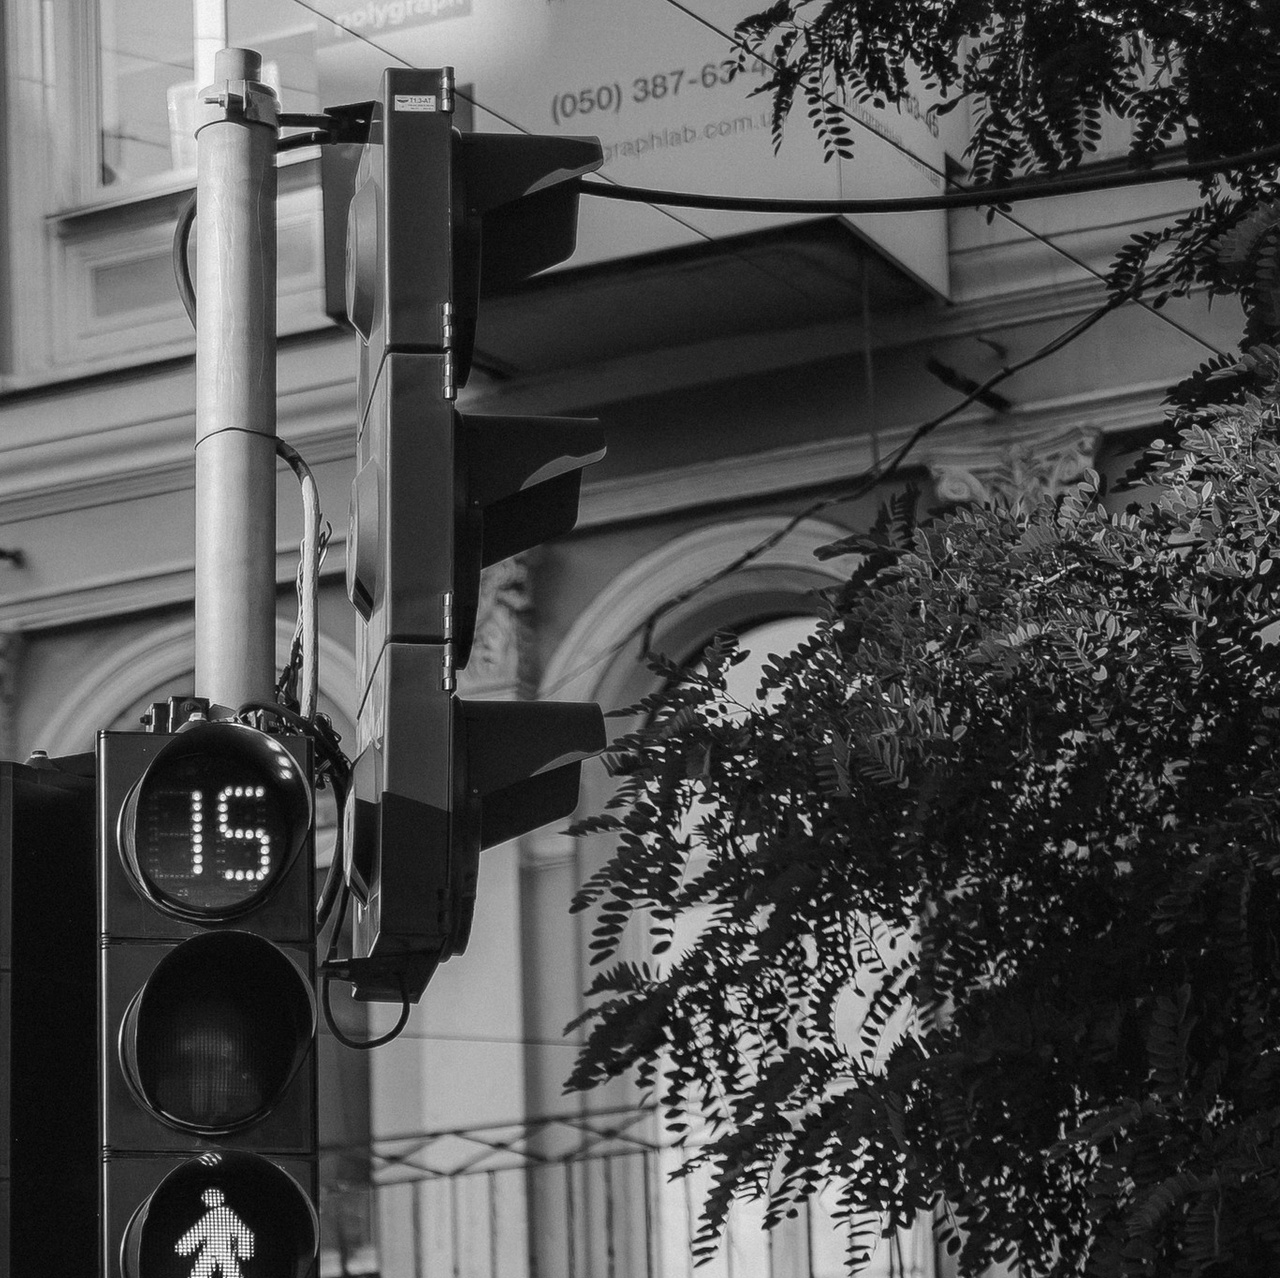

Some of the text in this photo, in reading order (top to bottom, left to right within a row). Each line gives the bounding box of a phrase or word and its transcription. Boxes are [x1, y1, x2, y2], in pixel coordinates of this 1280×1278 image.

[551, 48, 780, 126] (050) 387-63-4
[191, 785, 271, 881] 15
